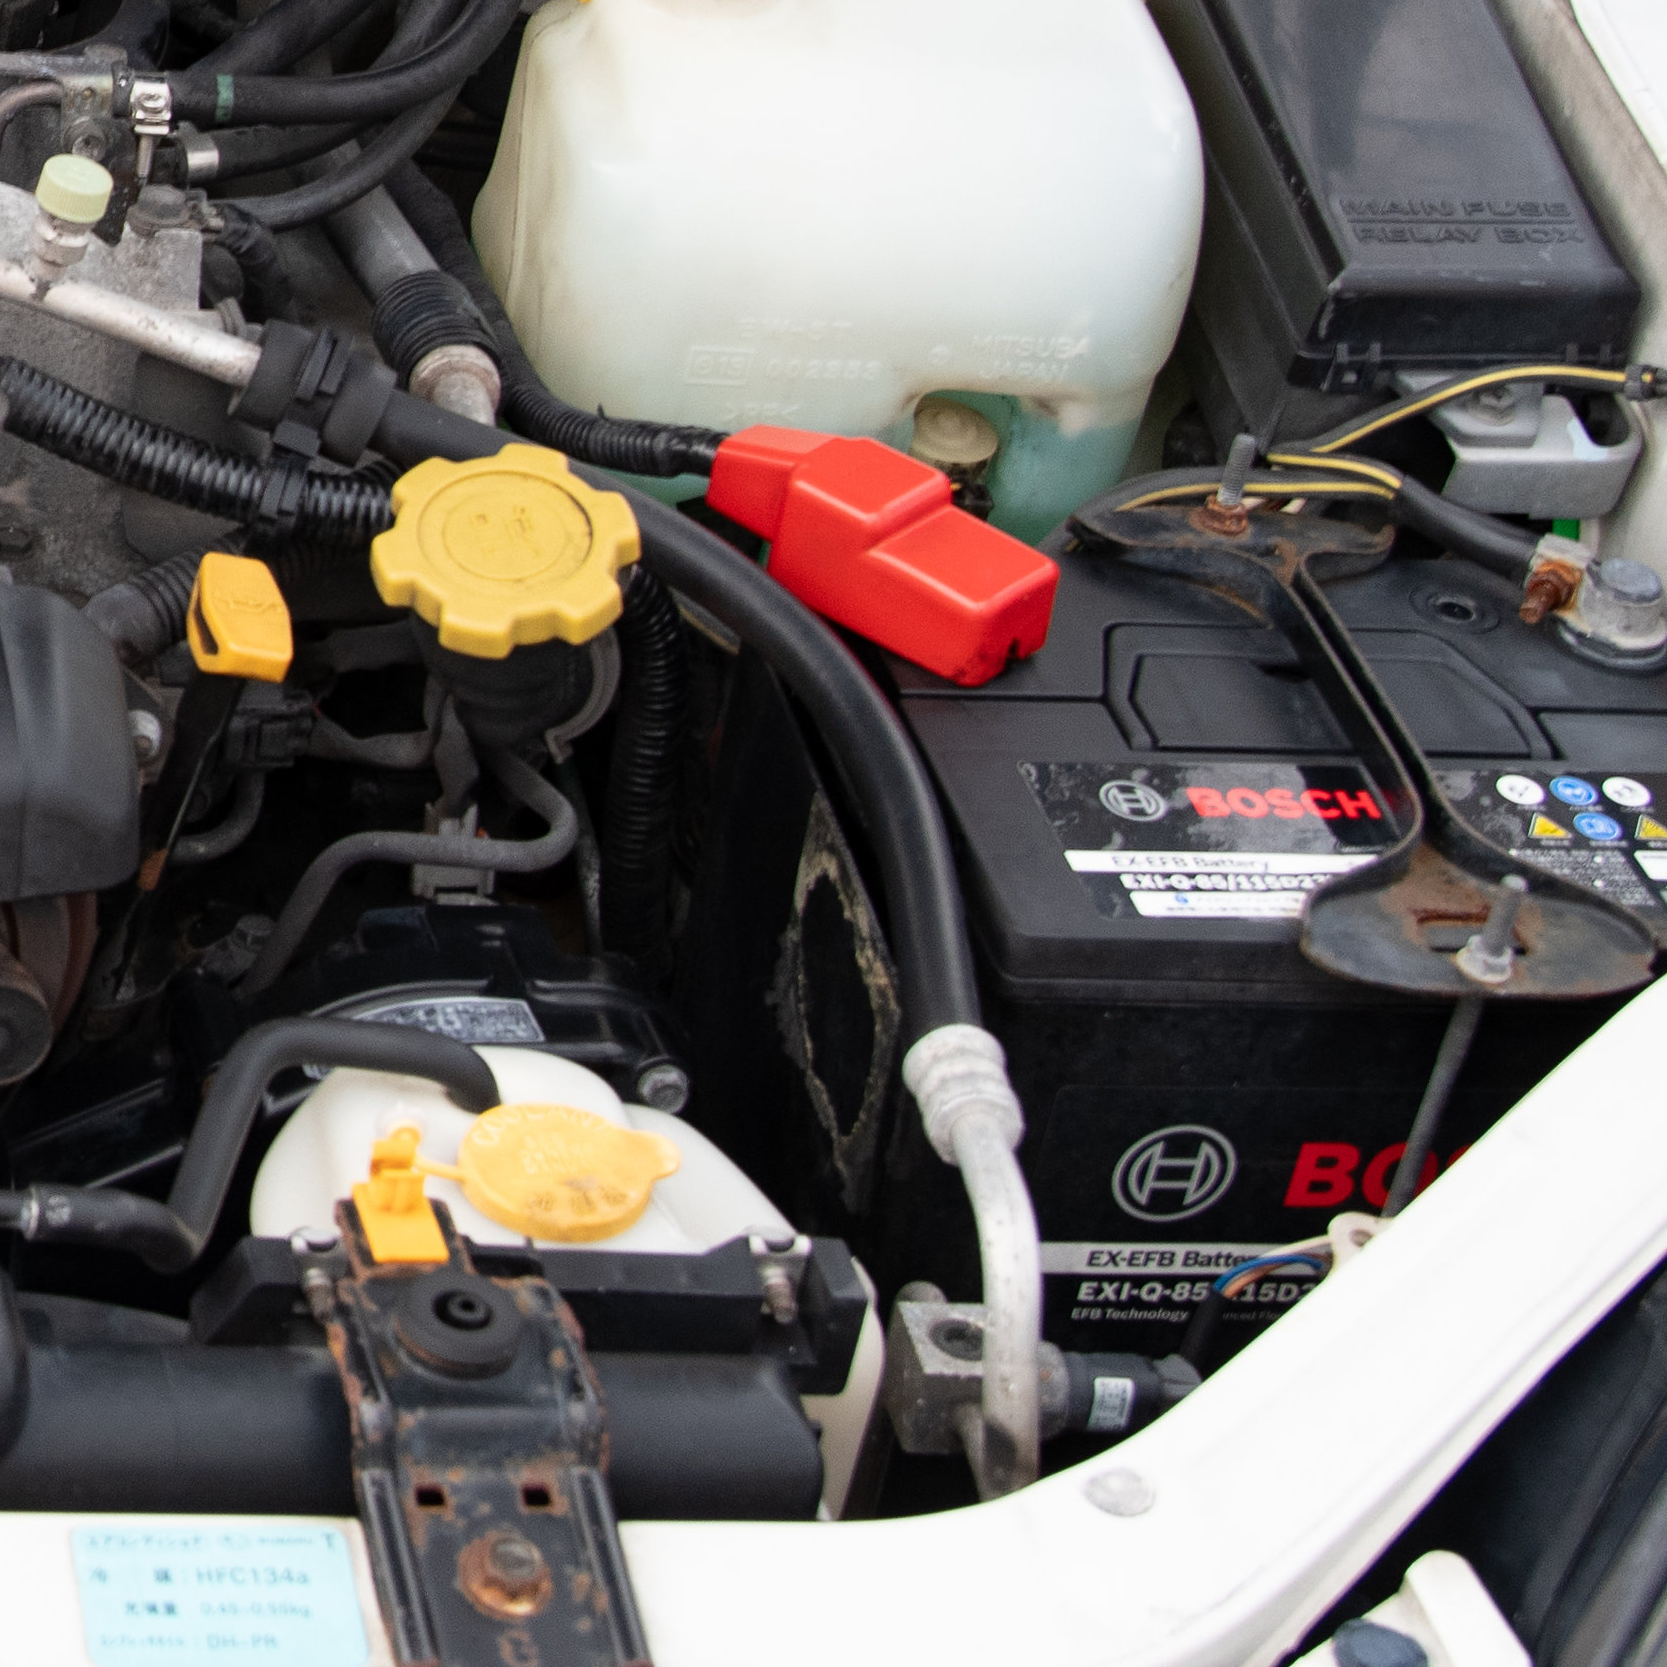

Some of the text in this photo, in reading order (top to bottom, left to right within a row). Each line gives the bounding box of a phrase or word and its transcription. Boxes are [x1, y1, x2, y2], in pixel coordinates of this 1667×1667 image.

[1185, 785, 1383, 821] BOSCH
[1192, 856, 1269, 873] Battery
[1085, 1250, 1175, 1268] EX-EFB
[1070, 1307, 1102, 1320] EFB
[1105, 1306, 1190, 1323] Technology
[195, 1565, 311, 1585] HFC134a
